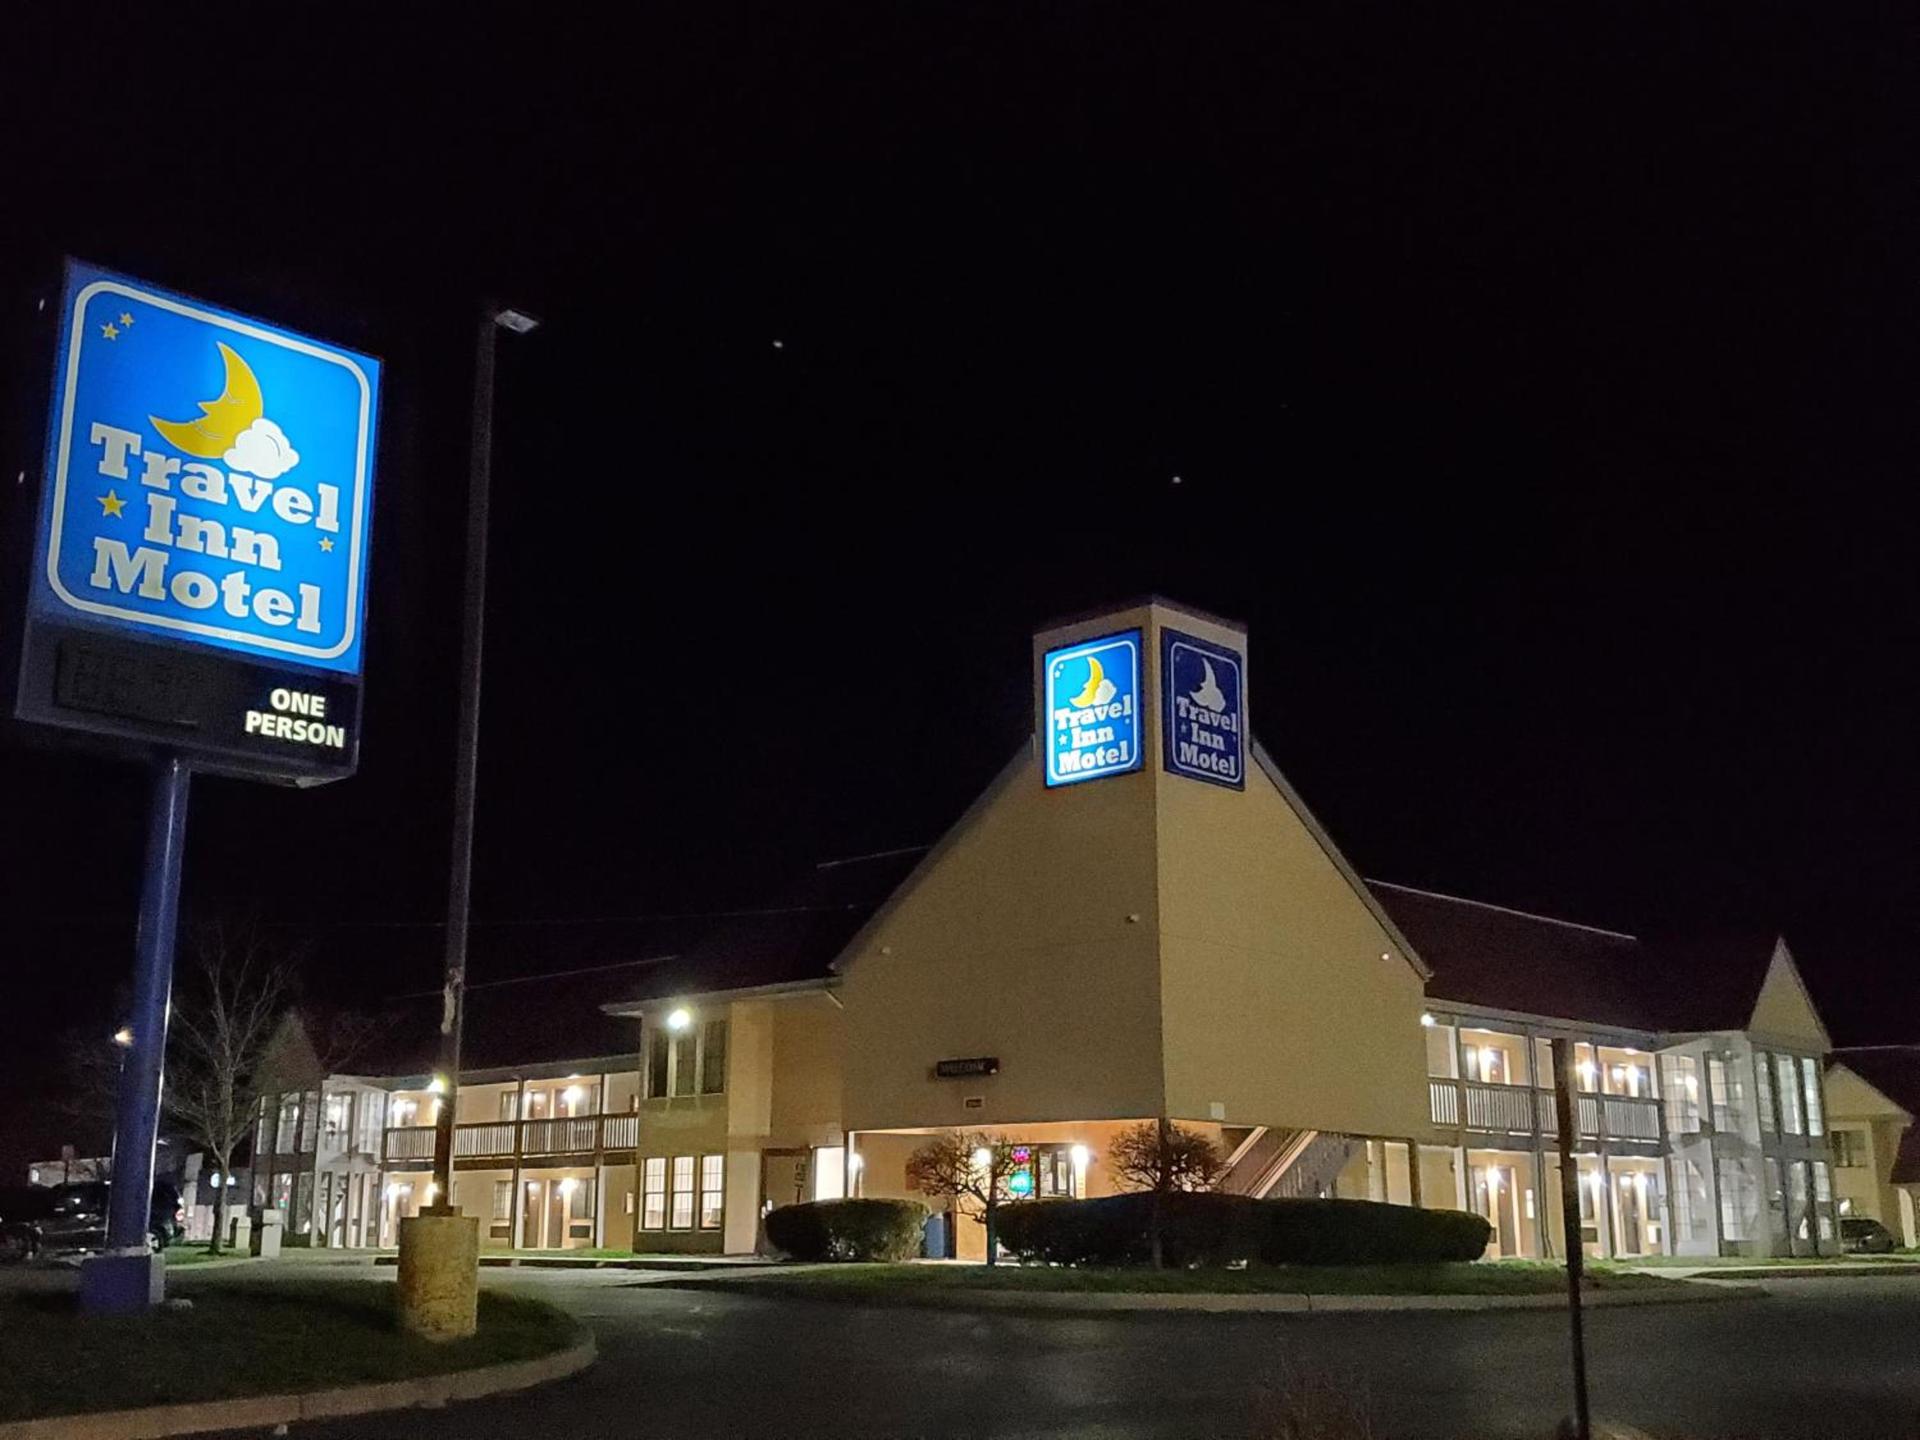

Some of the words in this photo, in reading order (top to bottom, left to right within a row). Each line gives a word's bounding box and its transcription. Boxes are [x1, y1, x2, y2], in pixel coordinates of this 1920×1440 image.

[91, 423, 339, 532] Travel
[145, 494, 281, 571] Inn
[91, 537, 321, 633] Motel
[270, 688, 325, 718] ONE
[1055, 695, 1131, 730] Travel
[1177, 696, 1238, 732] Travel
[245, 711, 345, 748] PERSON
[1071, 726, 1114, 749] Inn
[1191, 722, 1225, 750] Inn
[1058, 741, 1128, 774] Motel
[1180, 742, 1236, 775] Motel
